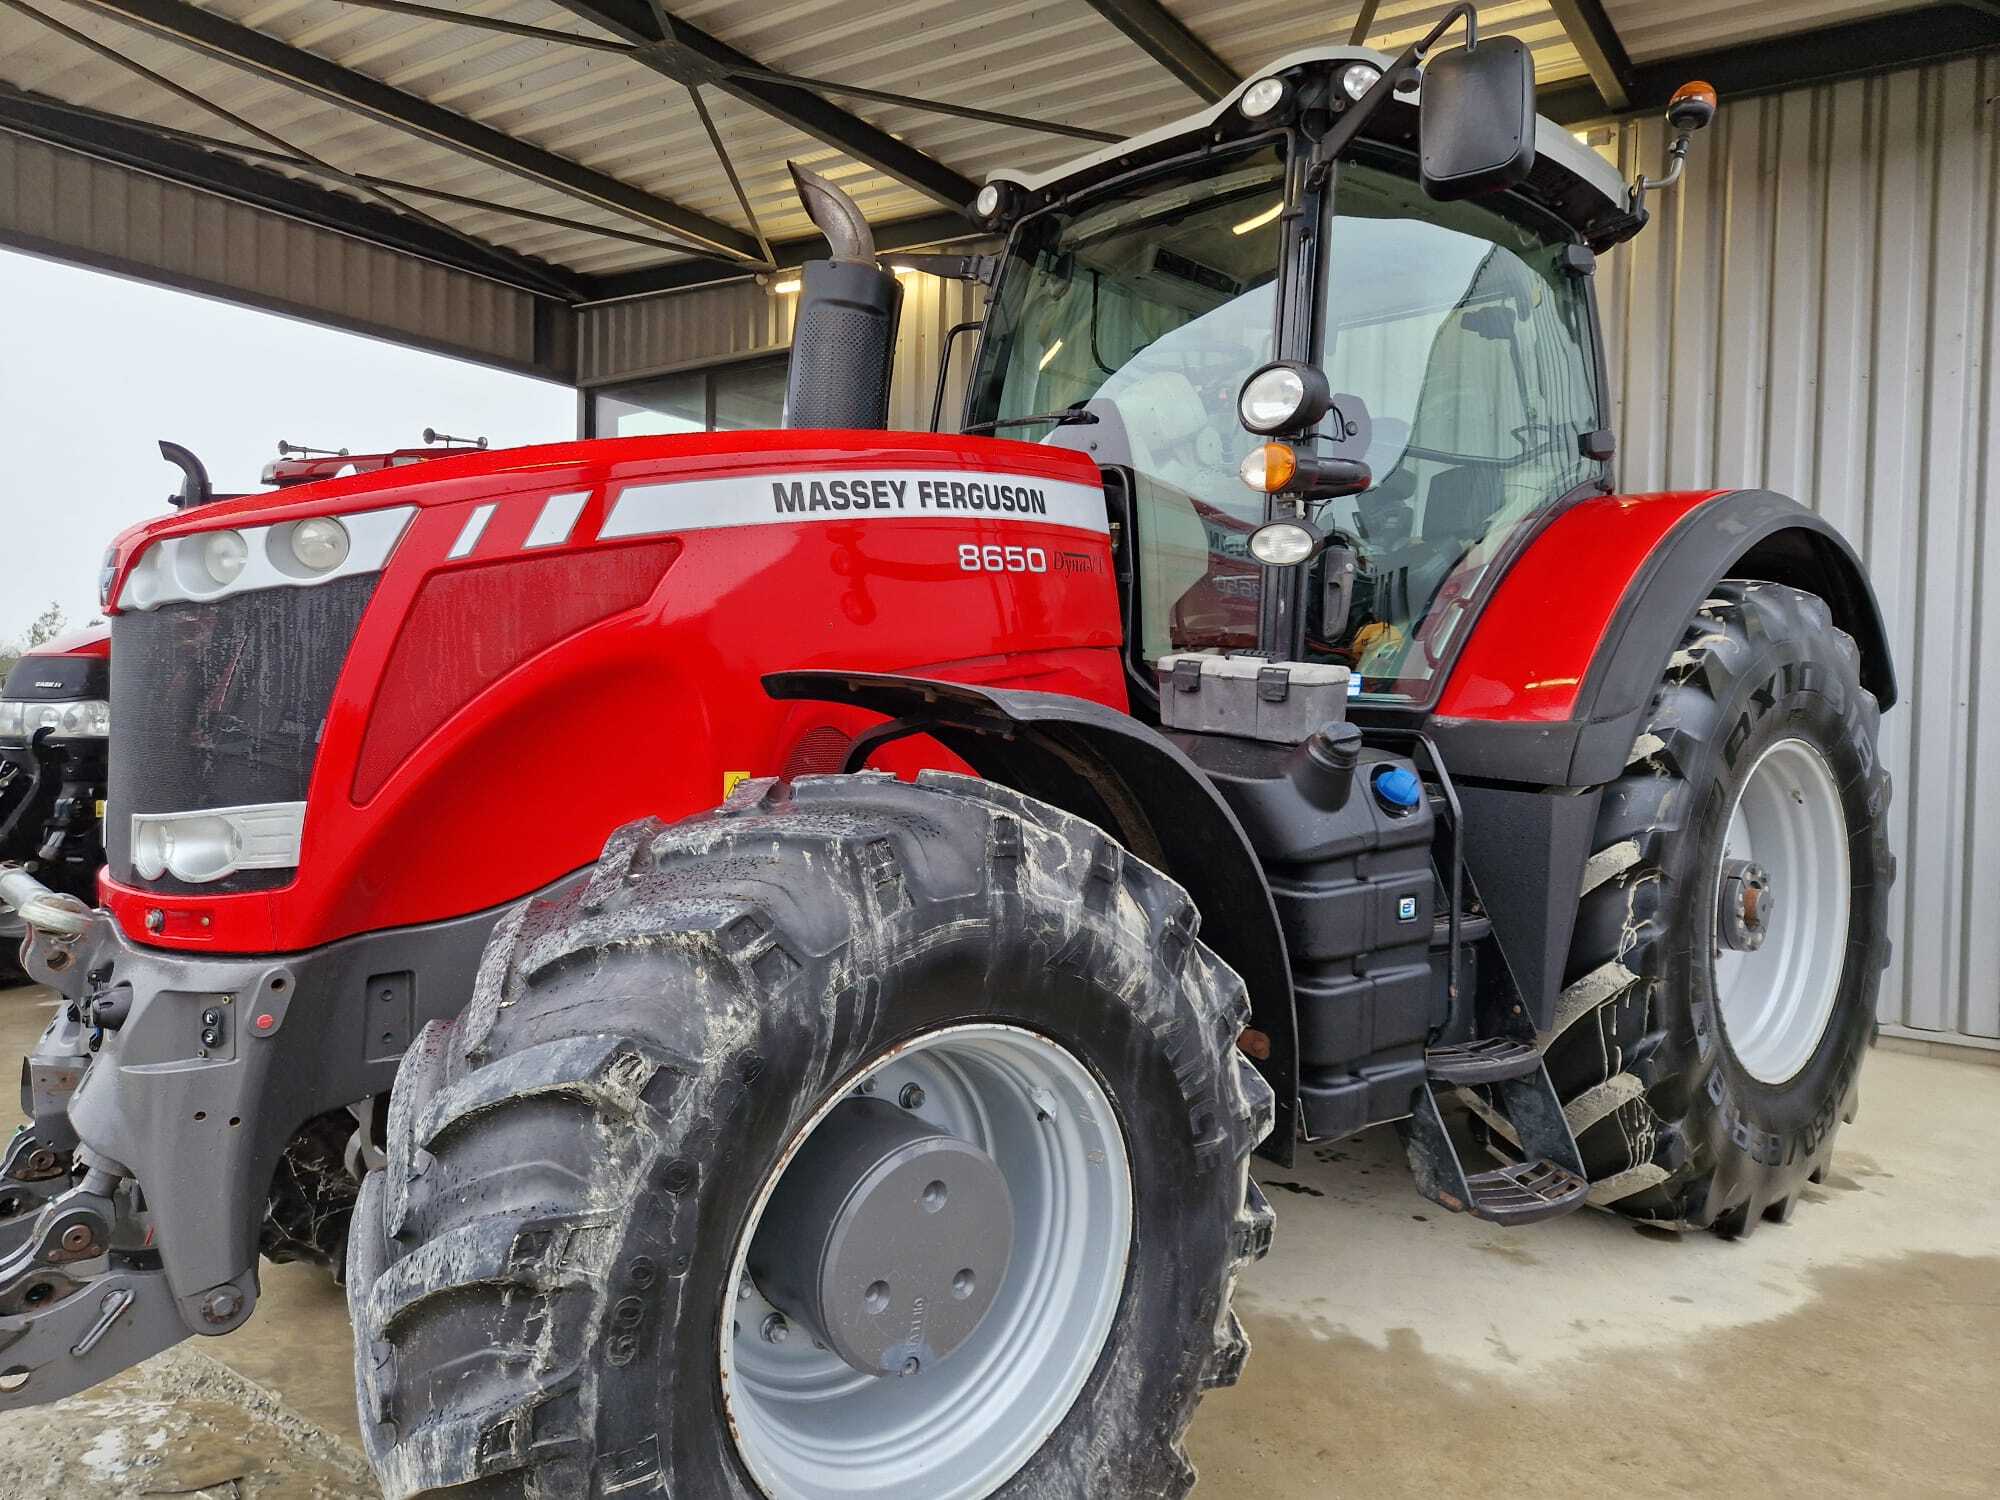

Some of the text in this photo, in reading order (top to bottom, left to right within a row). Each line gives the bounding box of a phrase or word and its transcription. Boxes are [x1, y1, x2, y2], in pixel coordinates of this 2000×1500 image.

[772, 479, 1047, 515] MASSEY FERGUSON
[958, 543, 1047, 573] 8650
